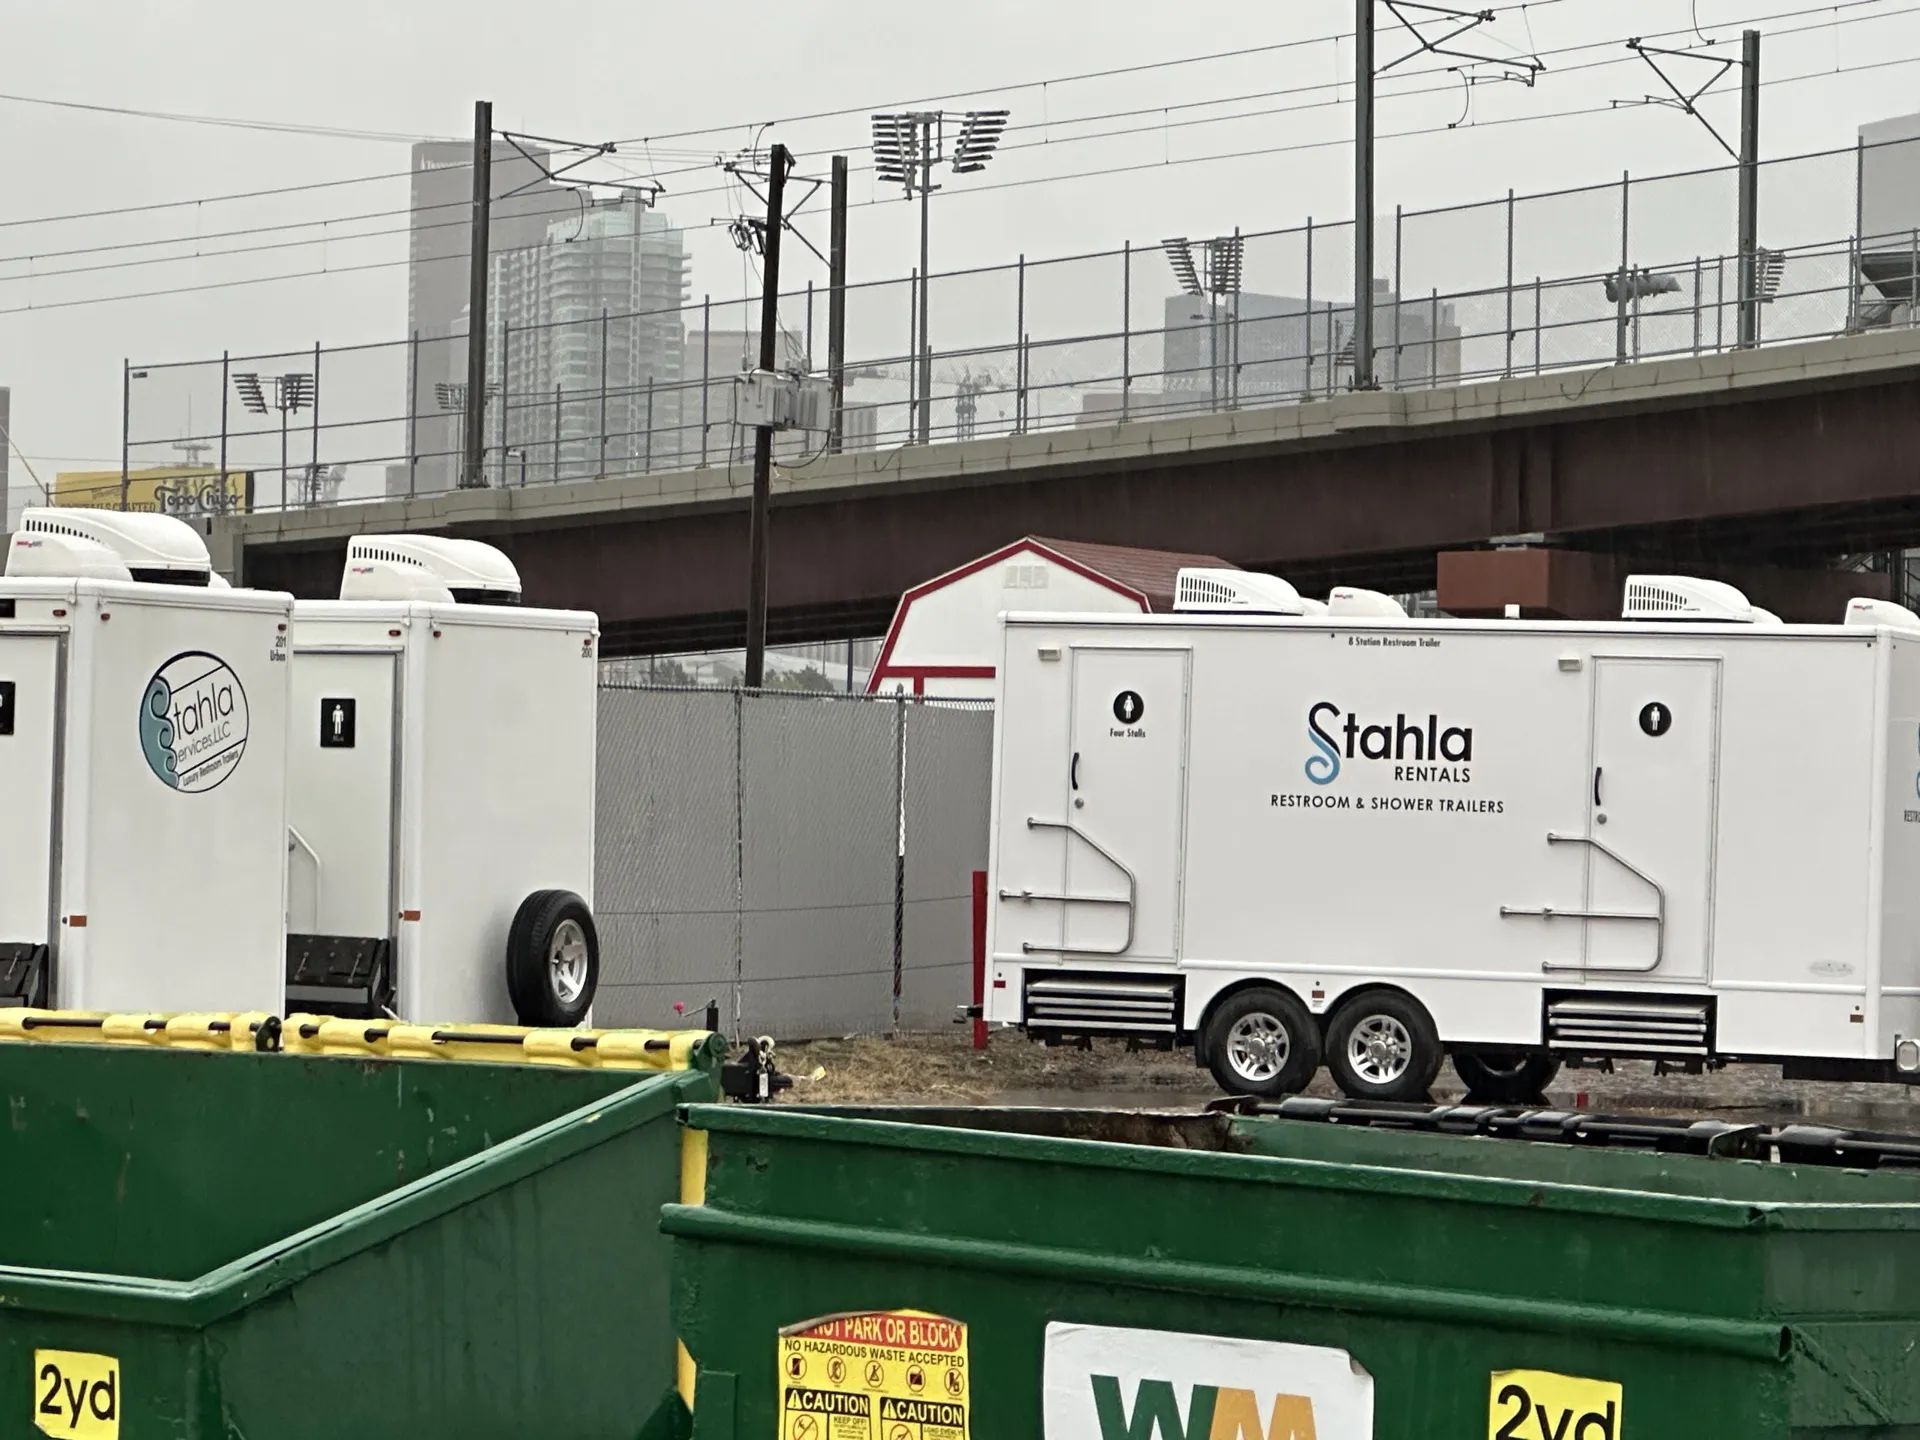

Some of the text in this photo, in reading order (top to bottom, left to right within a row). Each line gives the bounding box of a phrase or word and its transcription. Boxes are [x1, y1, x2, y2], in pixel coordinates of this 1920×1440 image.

[154, 486, 198, 512] Topo
[275, 635, 287, 648] 201
[581, 647, 592, 658] 200
[1348, 636, 1441, 647] 8 Station Restroom Trailer
[1110, 728, 1146, 738] Four Stalls
[1304, 701, 1473, 785] Stahla
[182, 771, 199, 787] Luxury
[199, 758, 223, 777] Restroom
[1394, 766, 1471, 783] RENTALS
[1271, 794, 1504, 813] RESTROOM & SHOWER TRAILERS
[844, 1317, 883, 1342] PARK
[886, 1318, 907, 1345] OR
[909, 1320, 959, 1349] BLOCK
[785, 1339, 965, 1367] NO HAZARDOUS WASTE ACCEPTED
[40, 1363, 115, 1428] 2yd
[803, 1391, 869, 1415] CAUTION
[1090, 1374, 1317, 1440] WM
[834, 1416, 851, 1424] KEEP
[897, 1401, 963, 1425] CAUTION
[1495, 1384, 1616, 1440] 2yd
